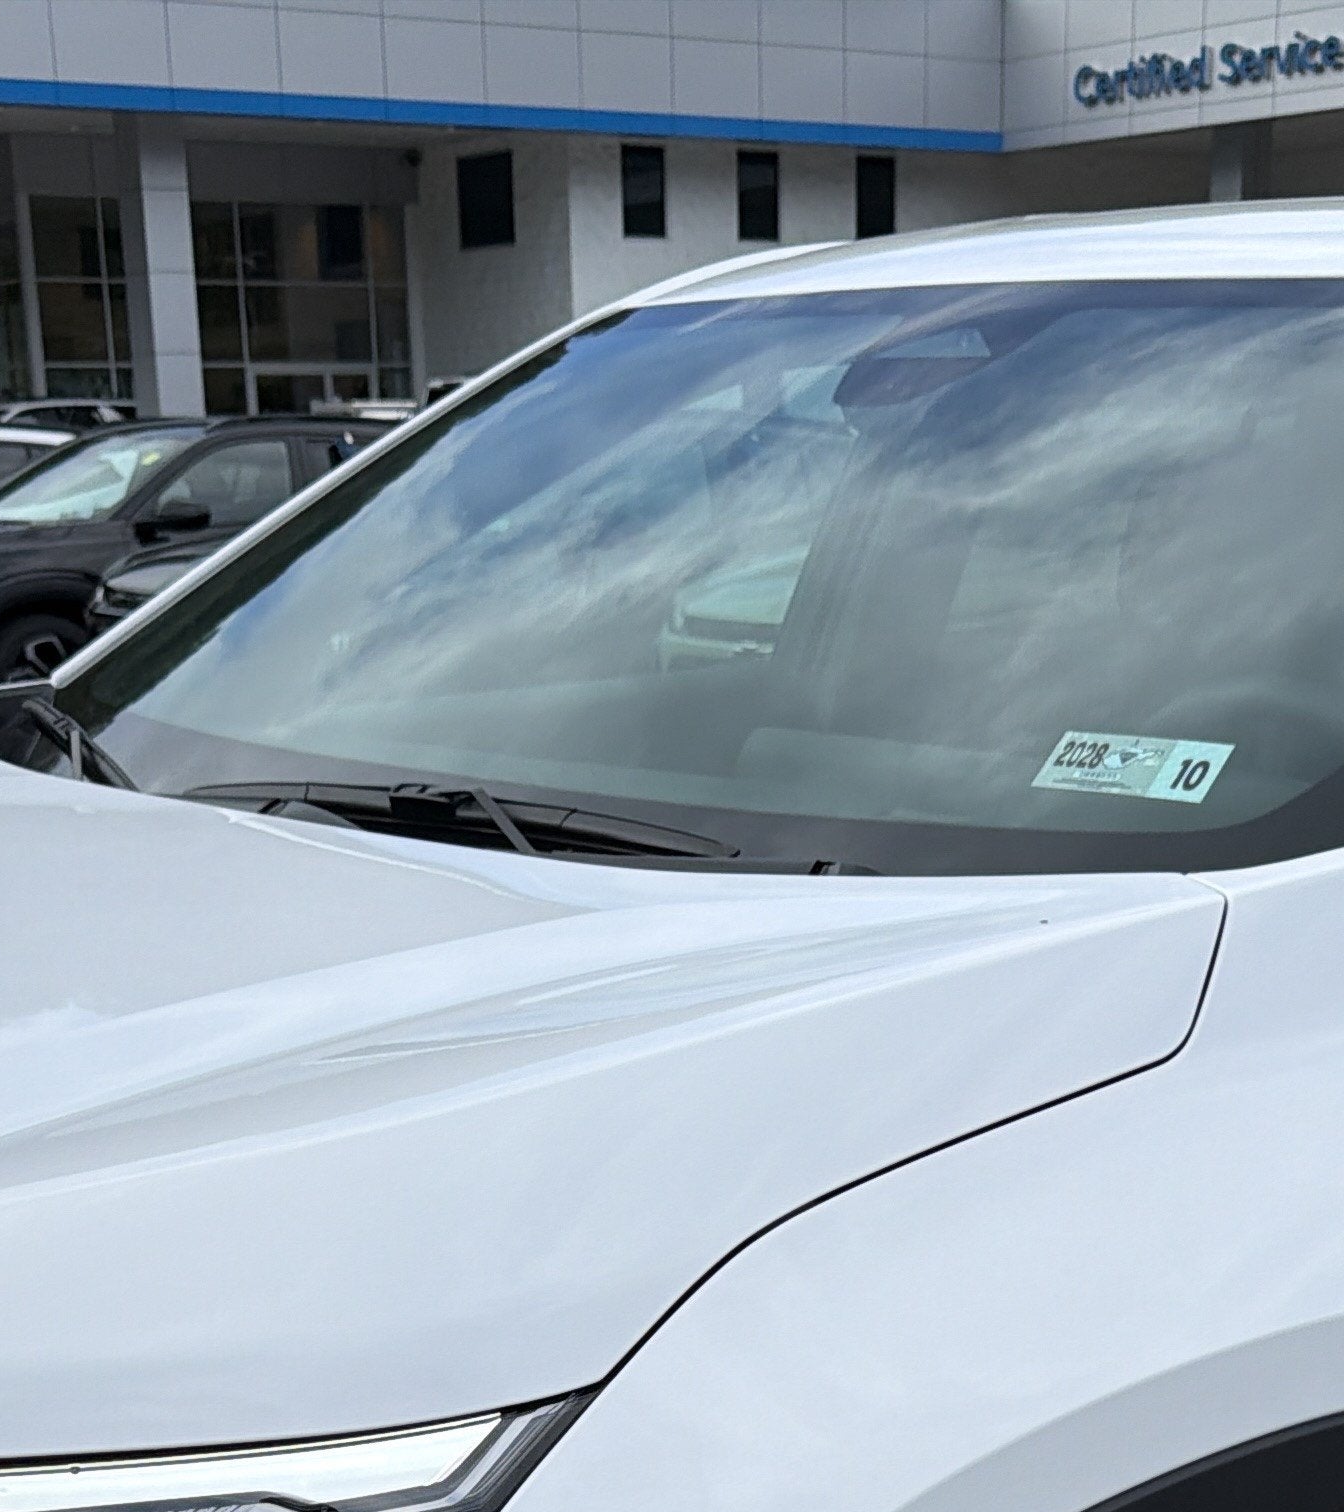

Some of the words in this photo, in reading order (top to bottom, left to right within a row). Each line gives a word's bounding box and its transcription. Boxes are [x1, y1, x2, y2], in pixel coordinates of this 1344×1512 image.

[1074, 47, 1209, 107] Certified
[1053, 741, 1110, 769] 2028
[1170, 759, 1210, 791] 10
